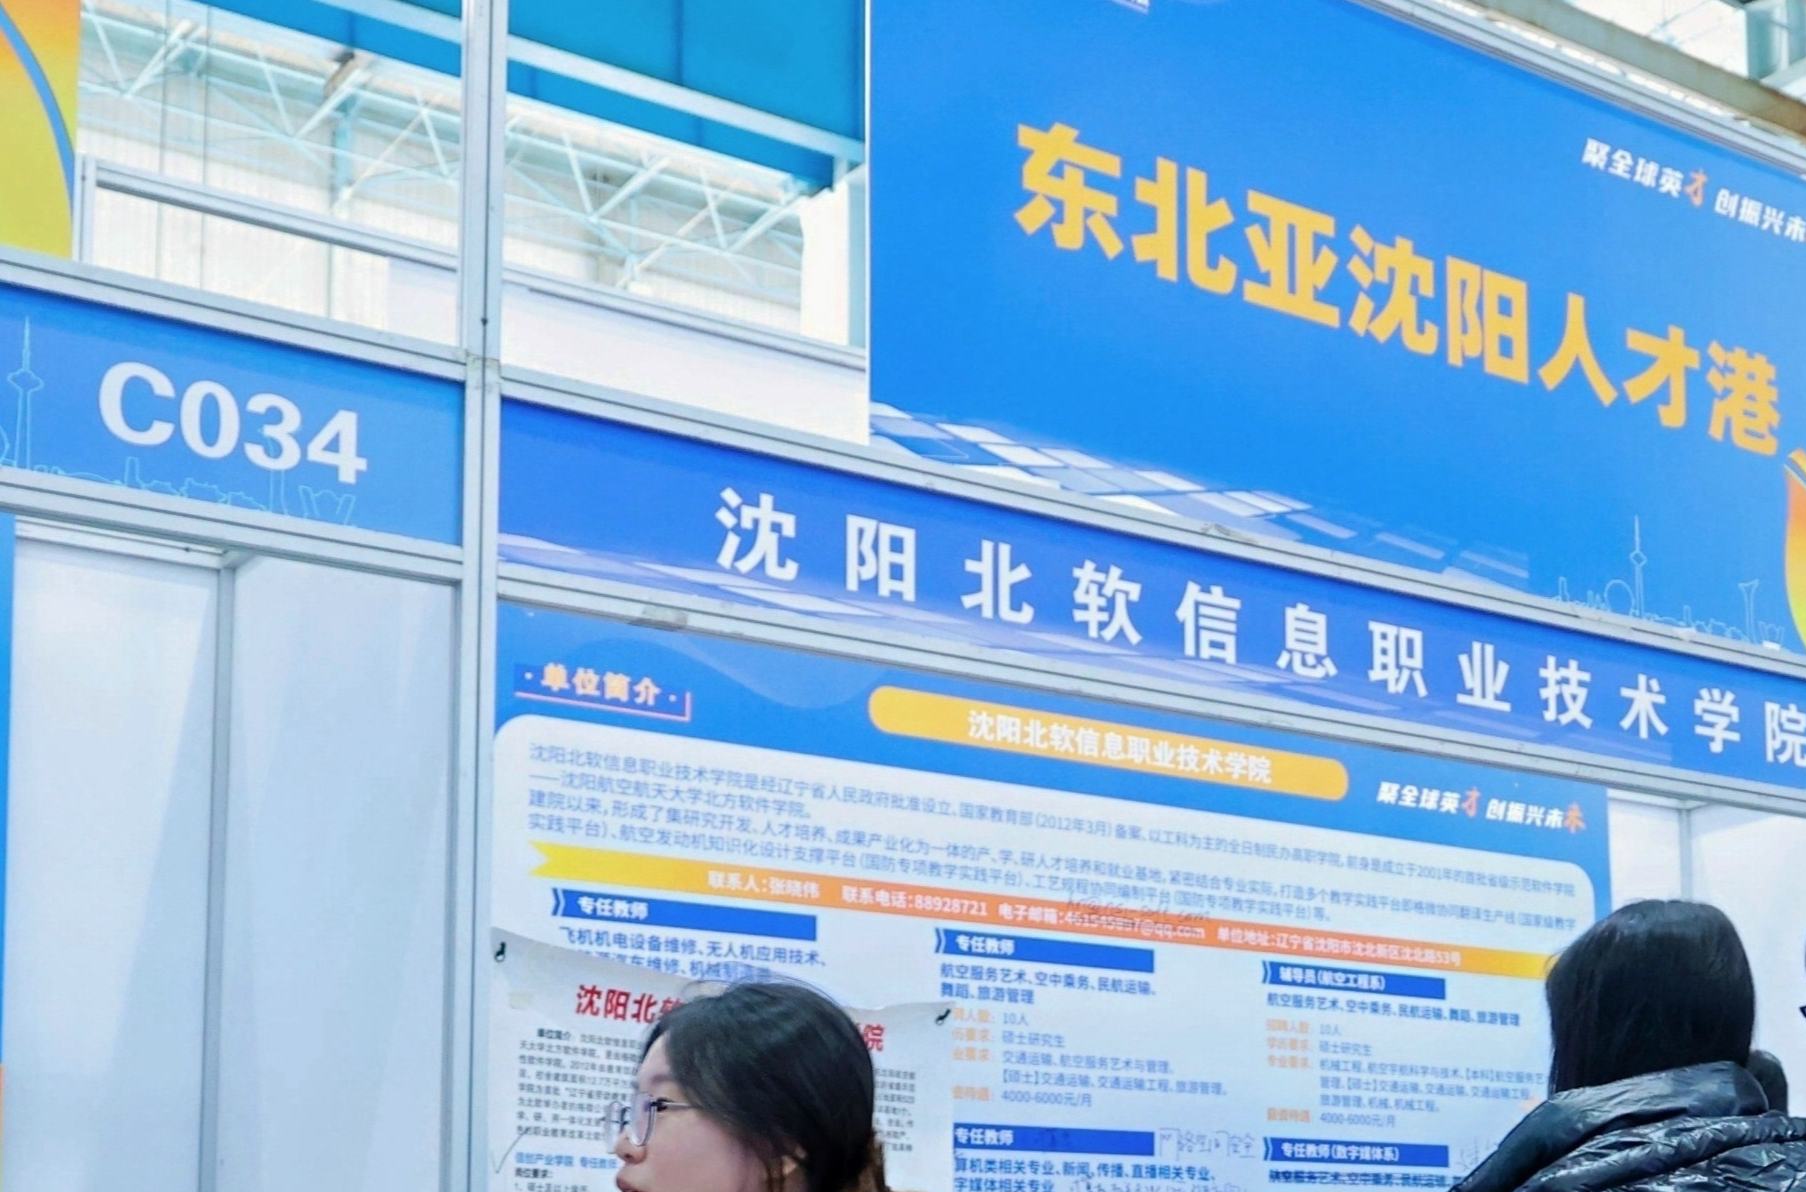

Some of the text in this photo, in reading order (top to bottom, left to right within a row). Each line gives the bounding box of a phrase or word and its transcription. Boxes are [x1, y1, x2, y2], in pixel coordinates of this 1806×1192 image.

[1582, 138, 1706, 206] 聚全球英才
[1014, 122, 1780, 453] 东北亚沈阳人才港
[98, 362, 368, 484] C034
[543, 661, 662, 706] 单位简介
[968, 710, 1273, 784] 沈阳北软信息职业技术学院
[1377, 780, 1479, 817] 聚全球英才
[577, 896, 648, 919] 专任教师
[956, 934, 1015, 956] 专任教师
[940, 982, 1034, 1005] 舞蹈、旅游管理
[954, 1128, 1015, 1146] 专任教师
